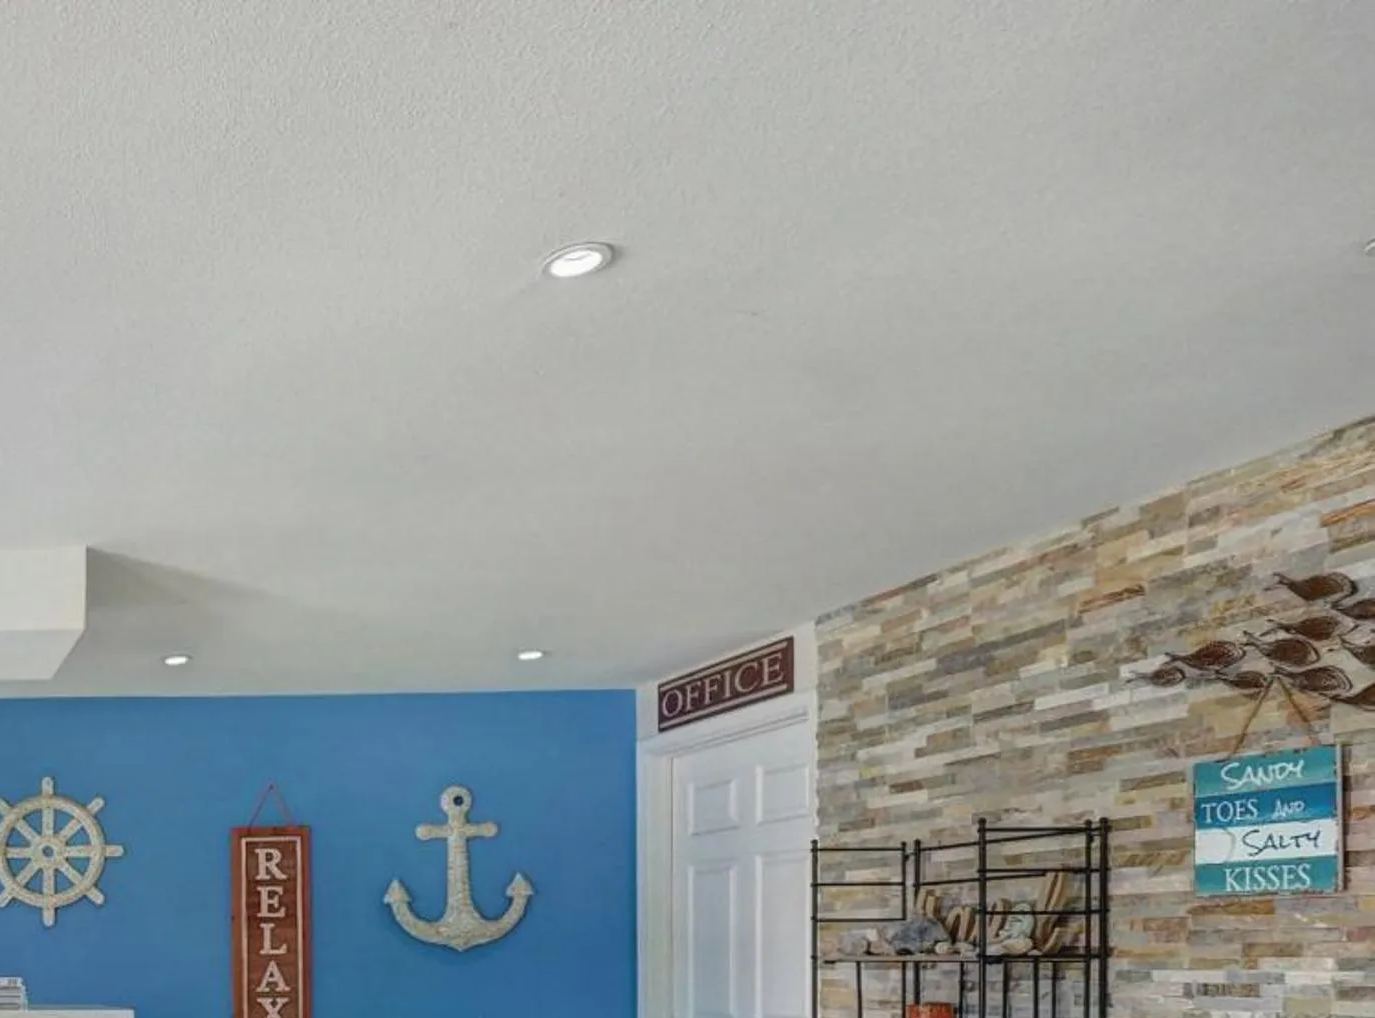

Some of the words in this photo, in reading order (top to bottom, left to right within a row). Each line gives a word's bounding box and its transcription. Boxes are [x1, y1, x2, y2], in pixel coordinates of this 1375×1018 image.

[662, 652, 783, 717] OFFICE
[1220, 759, 1305, 791] SANDY
[1200, 799, 1258, 823] TOES
[1241, 829, 1321, 857] SALTY
[1225, 863, 1311, 892] KISSES
